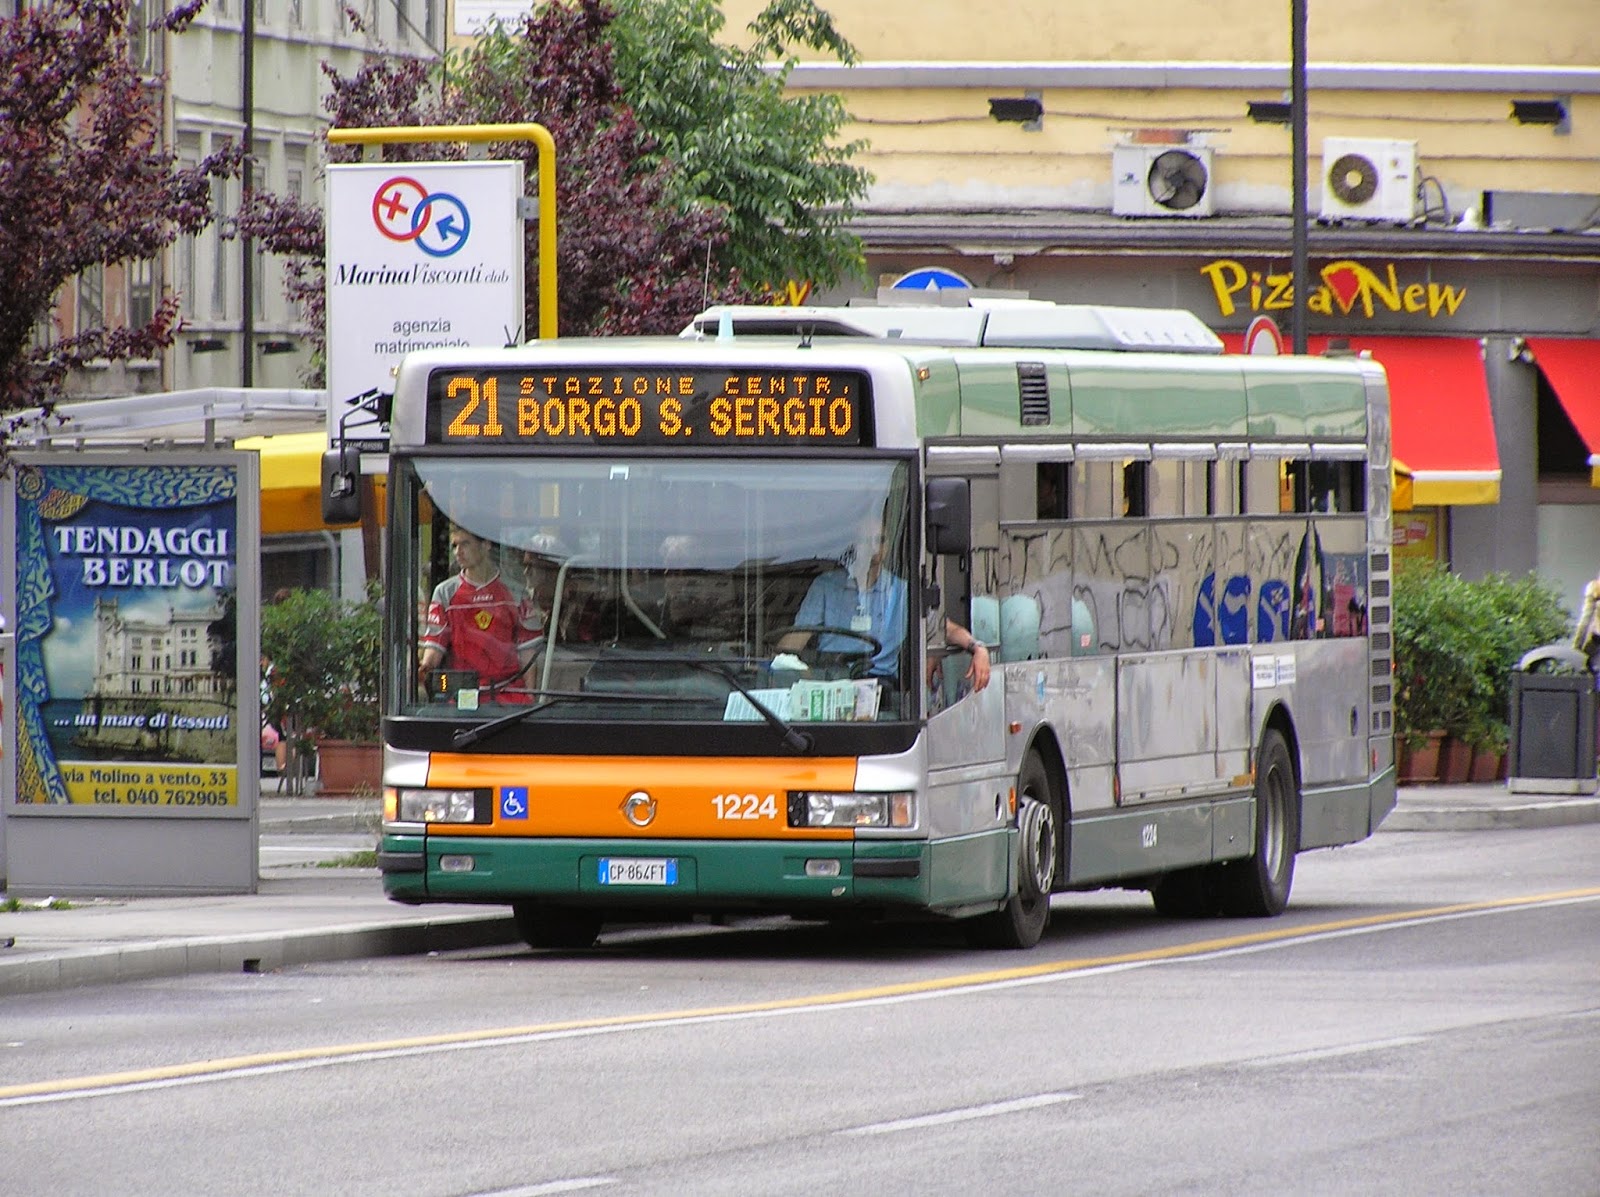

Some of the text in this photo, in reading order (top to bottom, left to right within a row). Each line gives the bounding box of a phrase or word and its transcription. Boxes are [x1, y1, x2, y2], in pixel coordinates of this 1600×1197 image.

[484, 270, 509, 284] club
[1200, 259, 1467, 319] Piza New
[392, 318, 452, 337] agenzia
[447, 377, 503, 436] 21
[520, 377, 694, 395] STAZIONE
[518, 397, 852, 437] BORGO S. SERGIO
[53, 526, 228, 556] TENDAGGI
[82, 558, 229, 588] BERLOT
[74, 713, 97, 727] un
[101, 714, 145, 728] mare
[148, 713, 167, 728] di
[171, 713, 229, 730] tessuti
[64, 769, 84, 782] via
[90, 770, 141, 784] Molino
[145, 774, 154, 784] a
[209, 772, 228, 786] 33
[94, 788, 228, 806] tel. 040 762905
[711, 793, 779, 820] 1224
[1142, 823, 1158, 848] 1224
